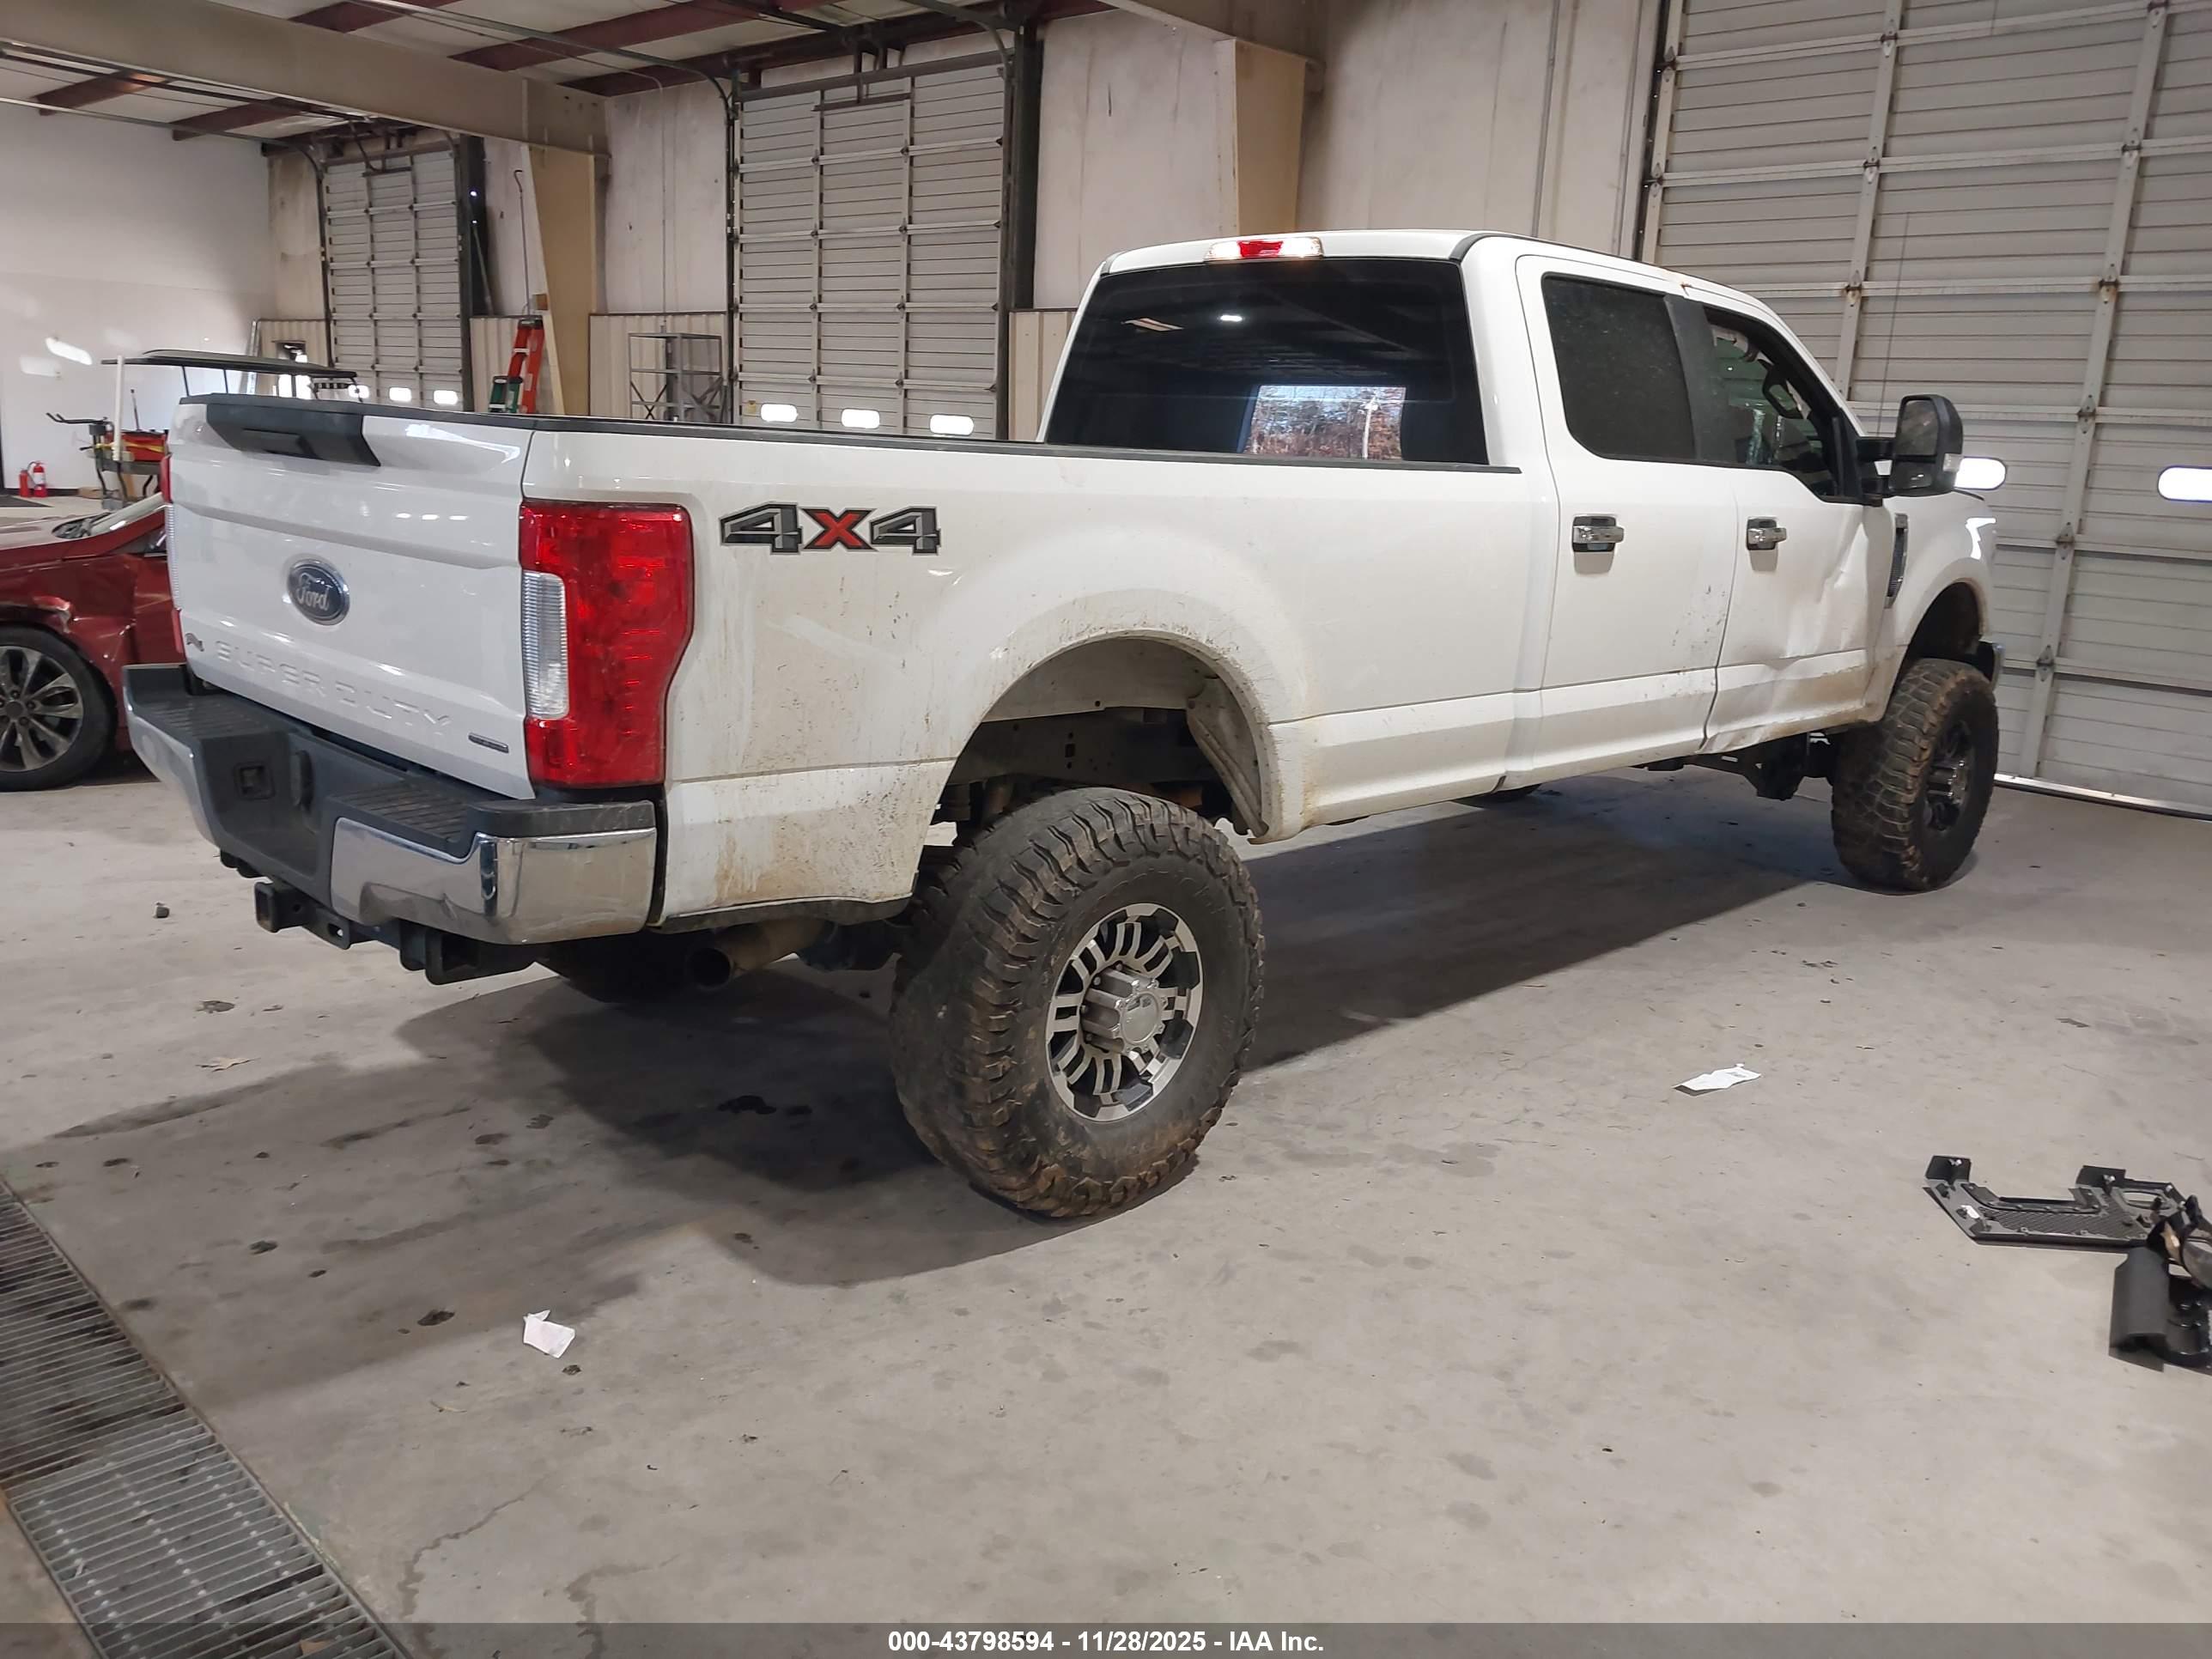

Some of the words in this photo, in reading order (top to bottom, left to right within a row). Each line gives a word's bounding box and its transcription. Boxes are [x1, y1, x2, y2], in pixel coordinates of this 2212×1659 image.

[296, 572, 333, 611] Ford
[216, 640, 326, 698] SUPER
[335, 680, 452, 736] DUTY
